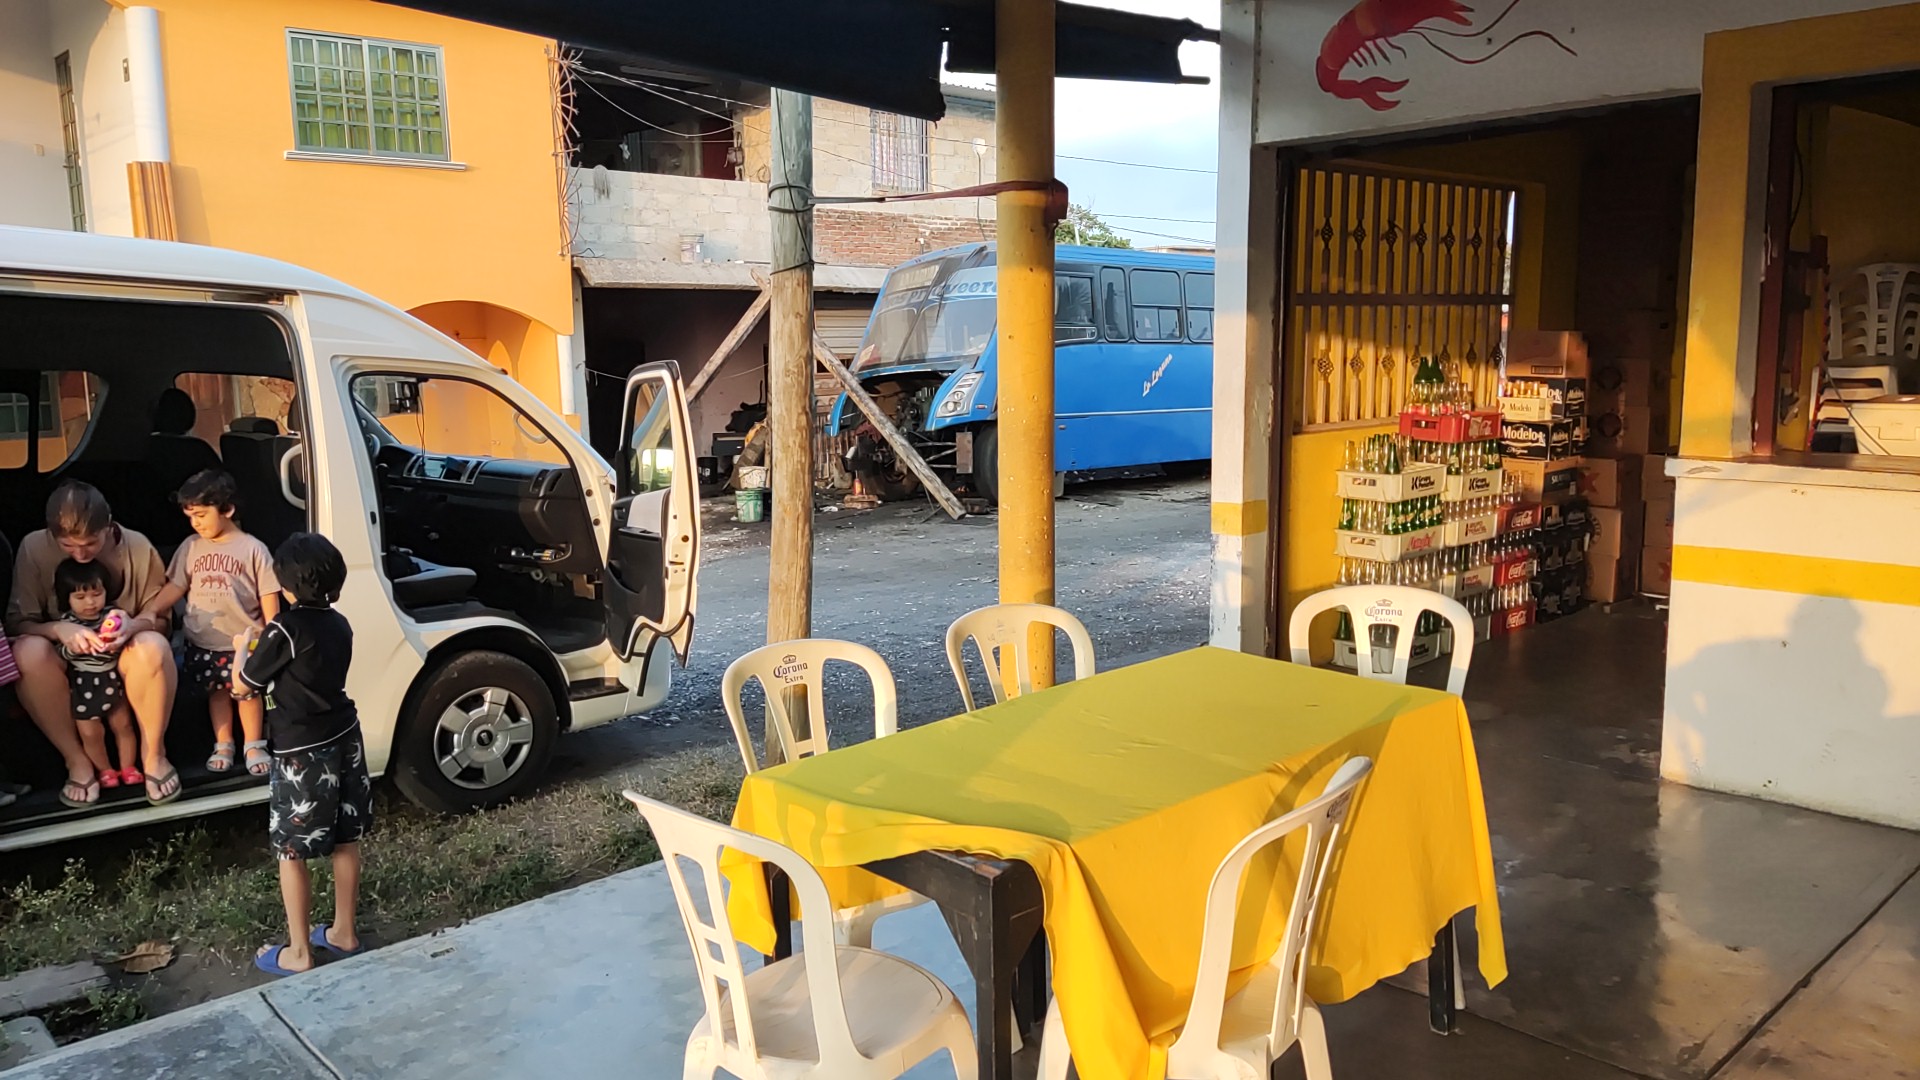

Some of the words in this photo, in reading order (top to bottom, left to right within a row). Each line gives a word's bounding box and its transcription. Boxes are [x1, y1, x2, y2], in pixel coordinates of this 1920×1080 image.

[1509, 403, 1532, 412] Modelo
[1502, 425, 1538, 441] Modelo
[194, 553, 243, 576] BROOKLYN
[1365, 606, 1403, 618] Corona
[773, 662, 808, 679] Corona
[784, 674, 804, 683] Extra
